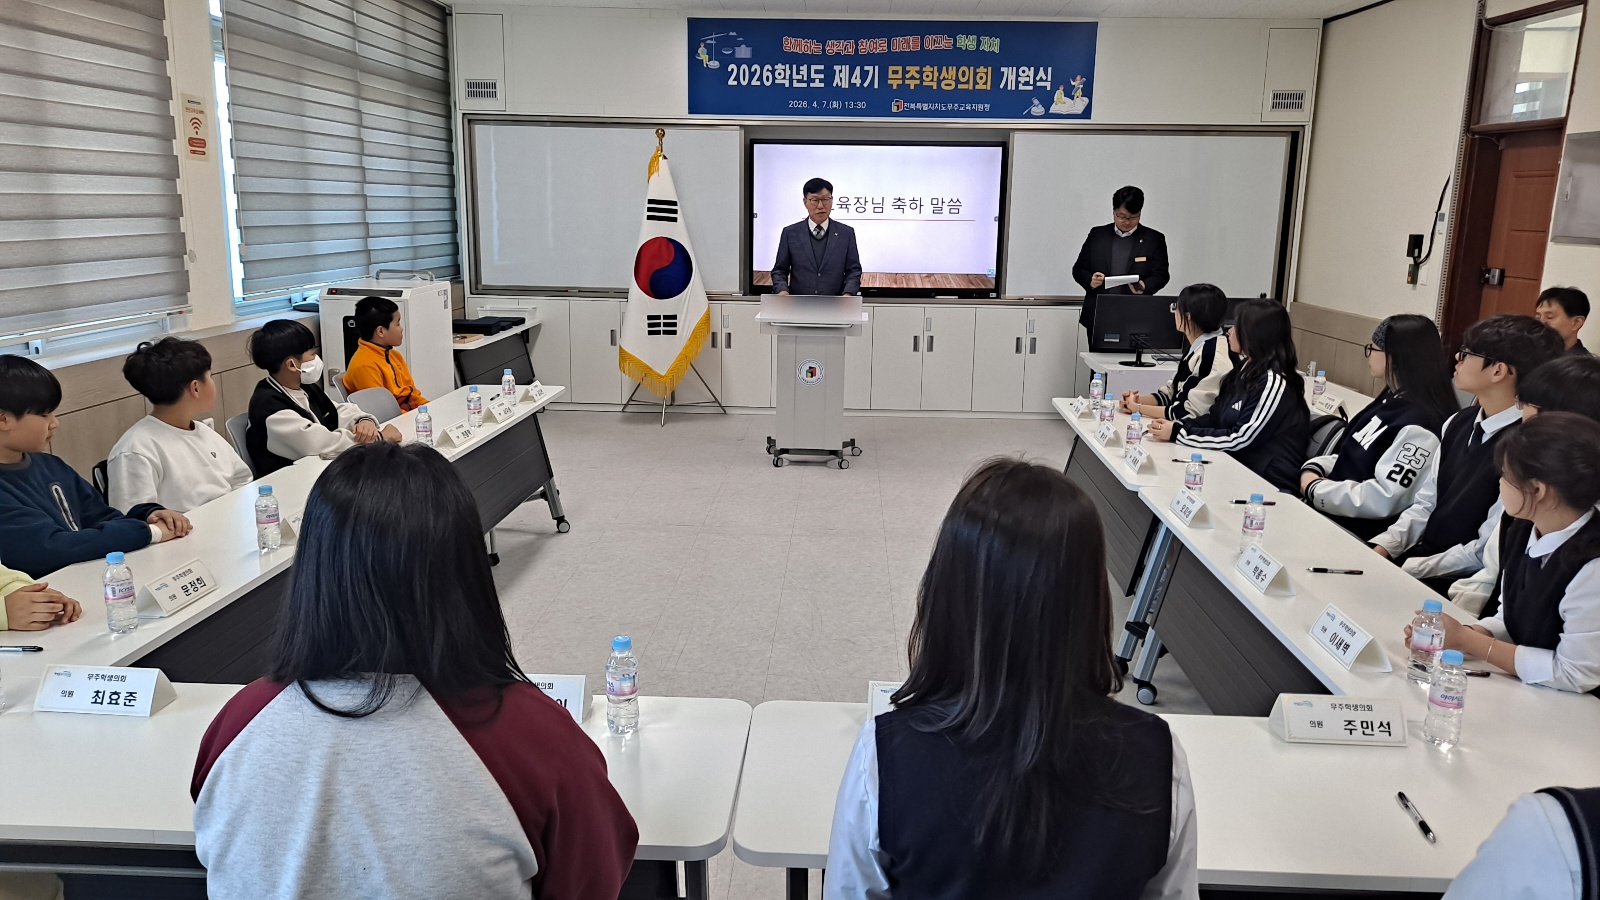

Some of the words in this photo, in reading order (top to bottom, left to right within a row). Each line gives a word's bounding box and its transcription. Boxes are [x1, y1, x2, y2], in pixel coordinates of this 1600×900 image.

[783, 36, 822, 54] 함께하는
[825, 40, 855, 55] 생각과
[858, 38, 888, 54] 참여로
[891, 36, 921, 52] 미래를
[924, 35, 953, 50] 이끄는
[956, 34, 977, 50] 학생
[979, 36, 1000, 53] 자치
[727, 63, 825, 88] 2026학년도
[832, 64, 879, 89] 제4기
[887, 65, 992, 91] 무주학생의회
[1000, 66, 1052, 91] 개원식
[789, 101, 810, 109] 2026.
[844, 101, 867, 109] 13:30
[831, 196, 885, 214] 육장님
[891, 196, 925, 214] 축하
[930, 197, 963, 214] 말씀
[1352, 415, 1388, 451] M
[1396, 442, 1431, 470] 25
[1386, 463, 1417, 489] 26
[181, 576, 207, 597] 문정희
[1328, 632, 1351, 656] 이새벽
[87, 673, 127, 683] 무주학생의회
[60, 690, 75, 698] 의원
[90, 689, 138, 707] 최효준
[1330, 703, 1373, 712] 무주학생의회
[1309, 720, 1323, 728] 의원
[1343, 719, 1392, 737] 주민석
